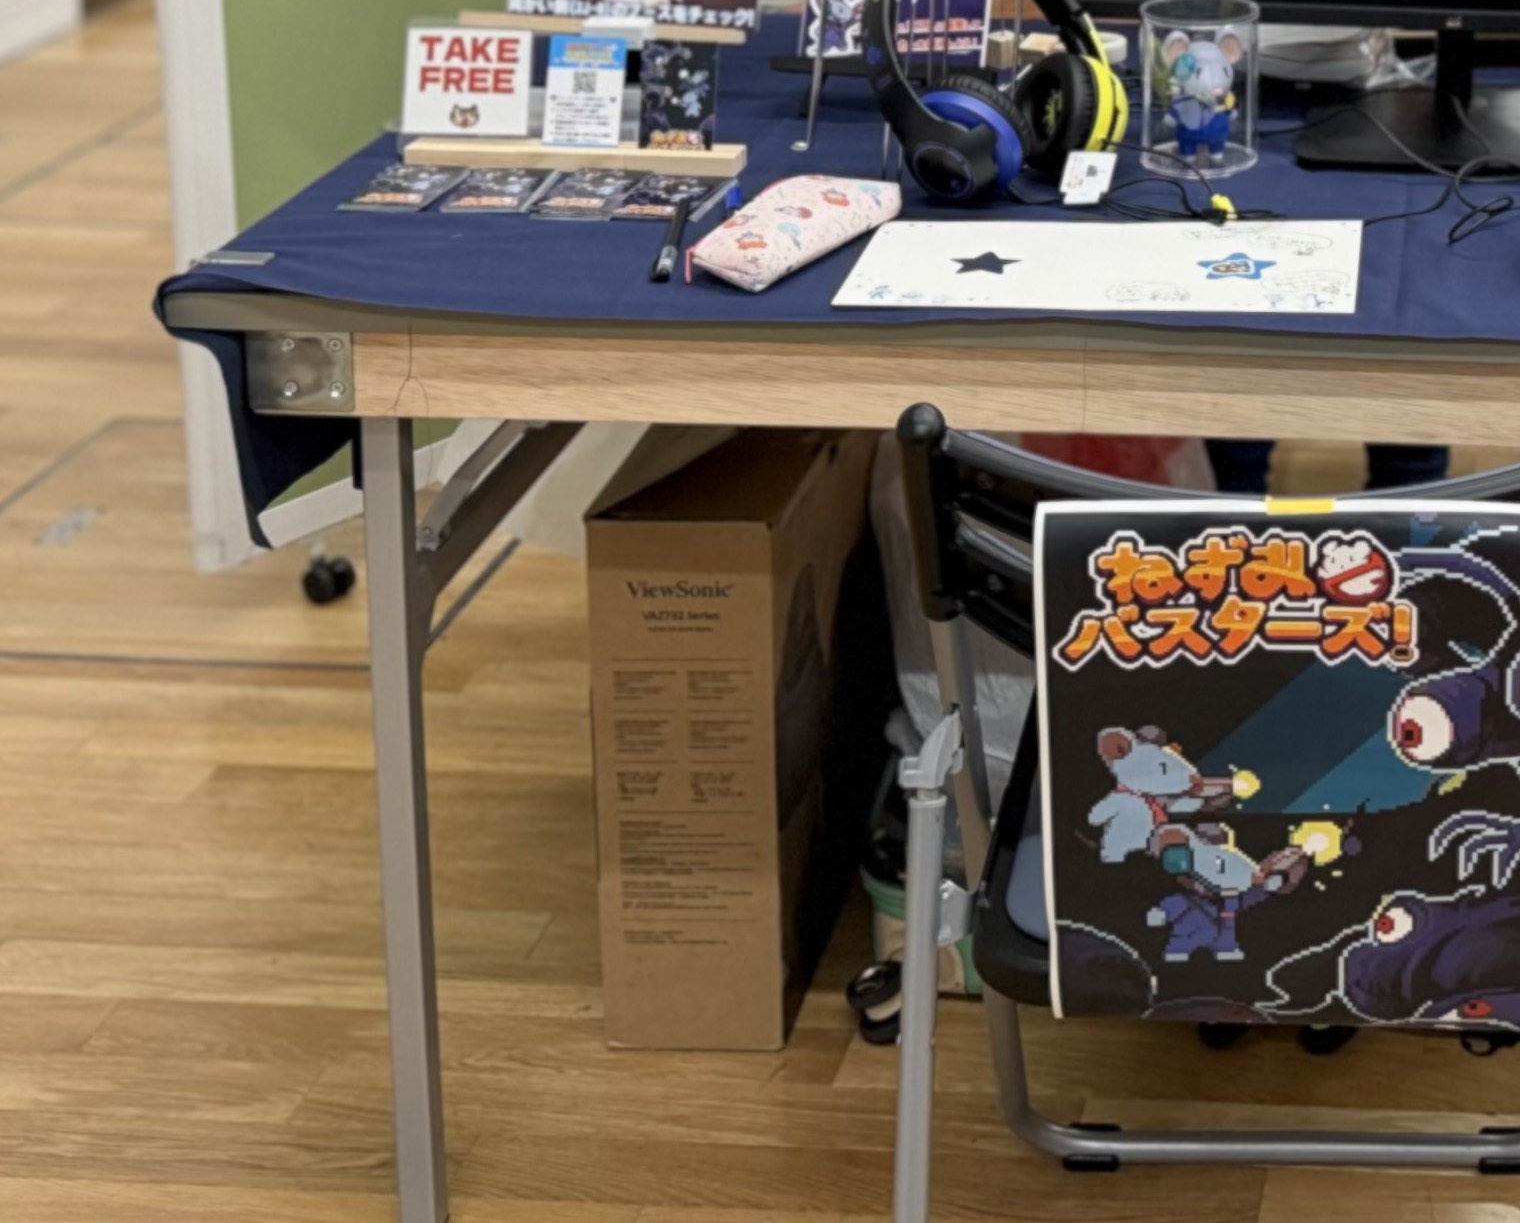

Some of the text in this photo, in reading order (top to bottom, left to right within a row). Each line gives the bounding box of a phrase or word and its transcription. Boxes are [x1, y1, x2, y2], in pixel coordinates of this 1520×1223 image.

[419, 35, 520, 64] TAKE
[419, 67, 516, 94] FREE
[1092, 531, 1317, 604] ねずみ
[625, 580, 732, 598] ViewSonic
[1057, 599, 1418, 667] バスターズ!
